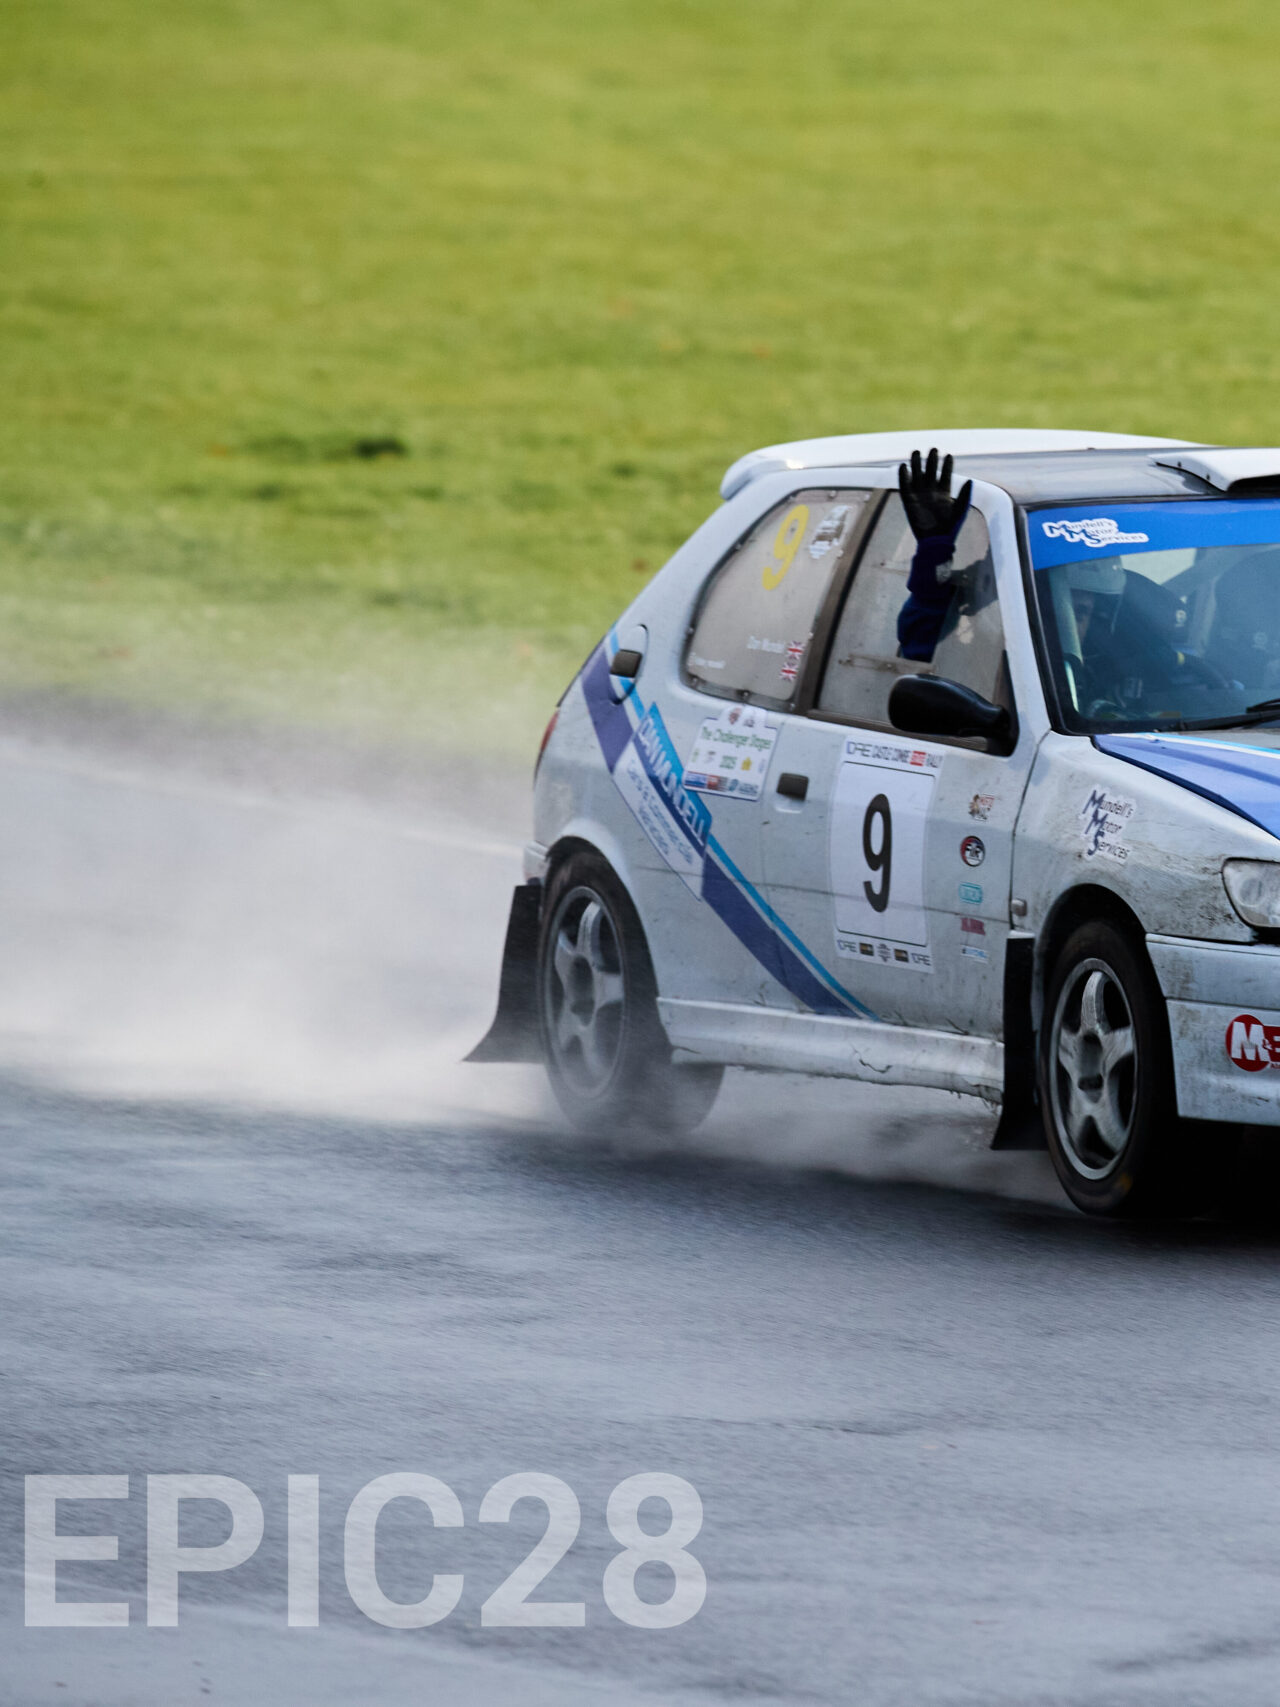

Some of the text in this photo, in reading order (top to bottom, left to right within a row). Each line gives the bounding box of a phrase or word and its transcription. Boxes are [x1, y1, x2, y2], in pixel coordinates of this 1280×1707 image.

[762, 504, 809, 590] 9
[1082, 790, 1134, 818] Mundell's
[1085, 808, 1122, 835] Motor
[863, 793, 892, 912] 9
[1087, 830, 1130, 859] Services
